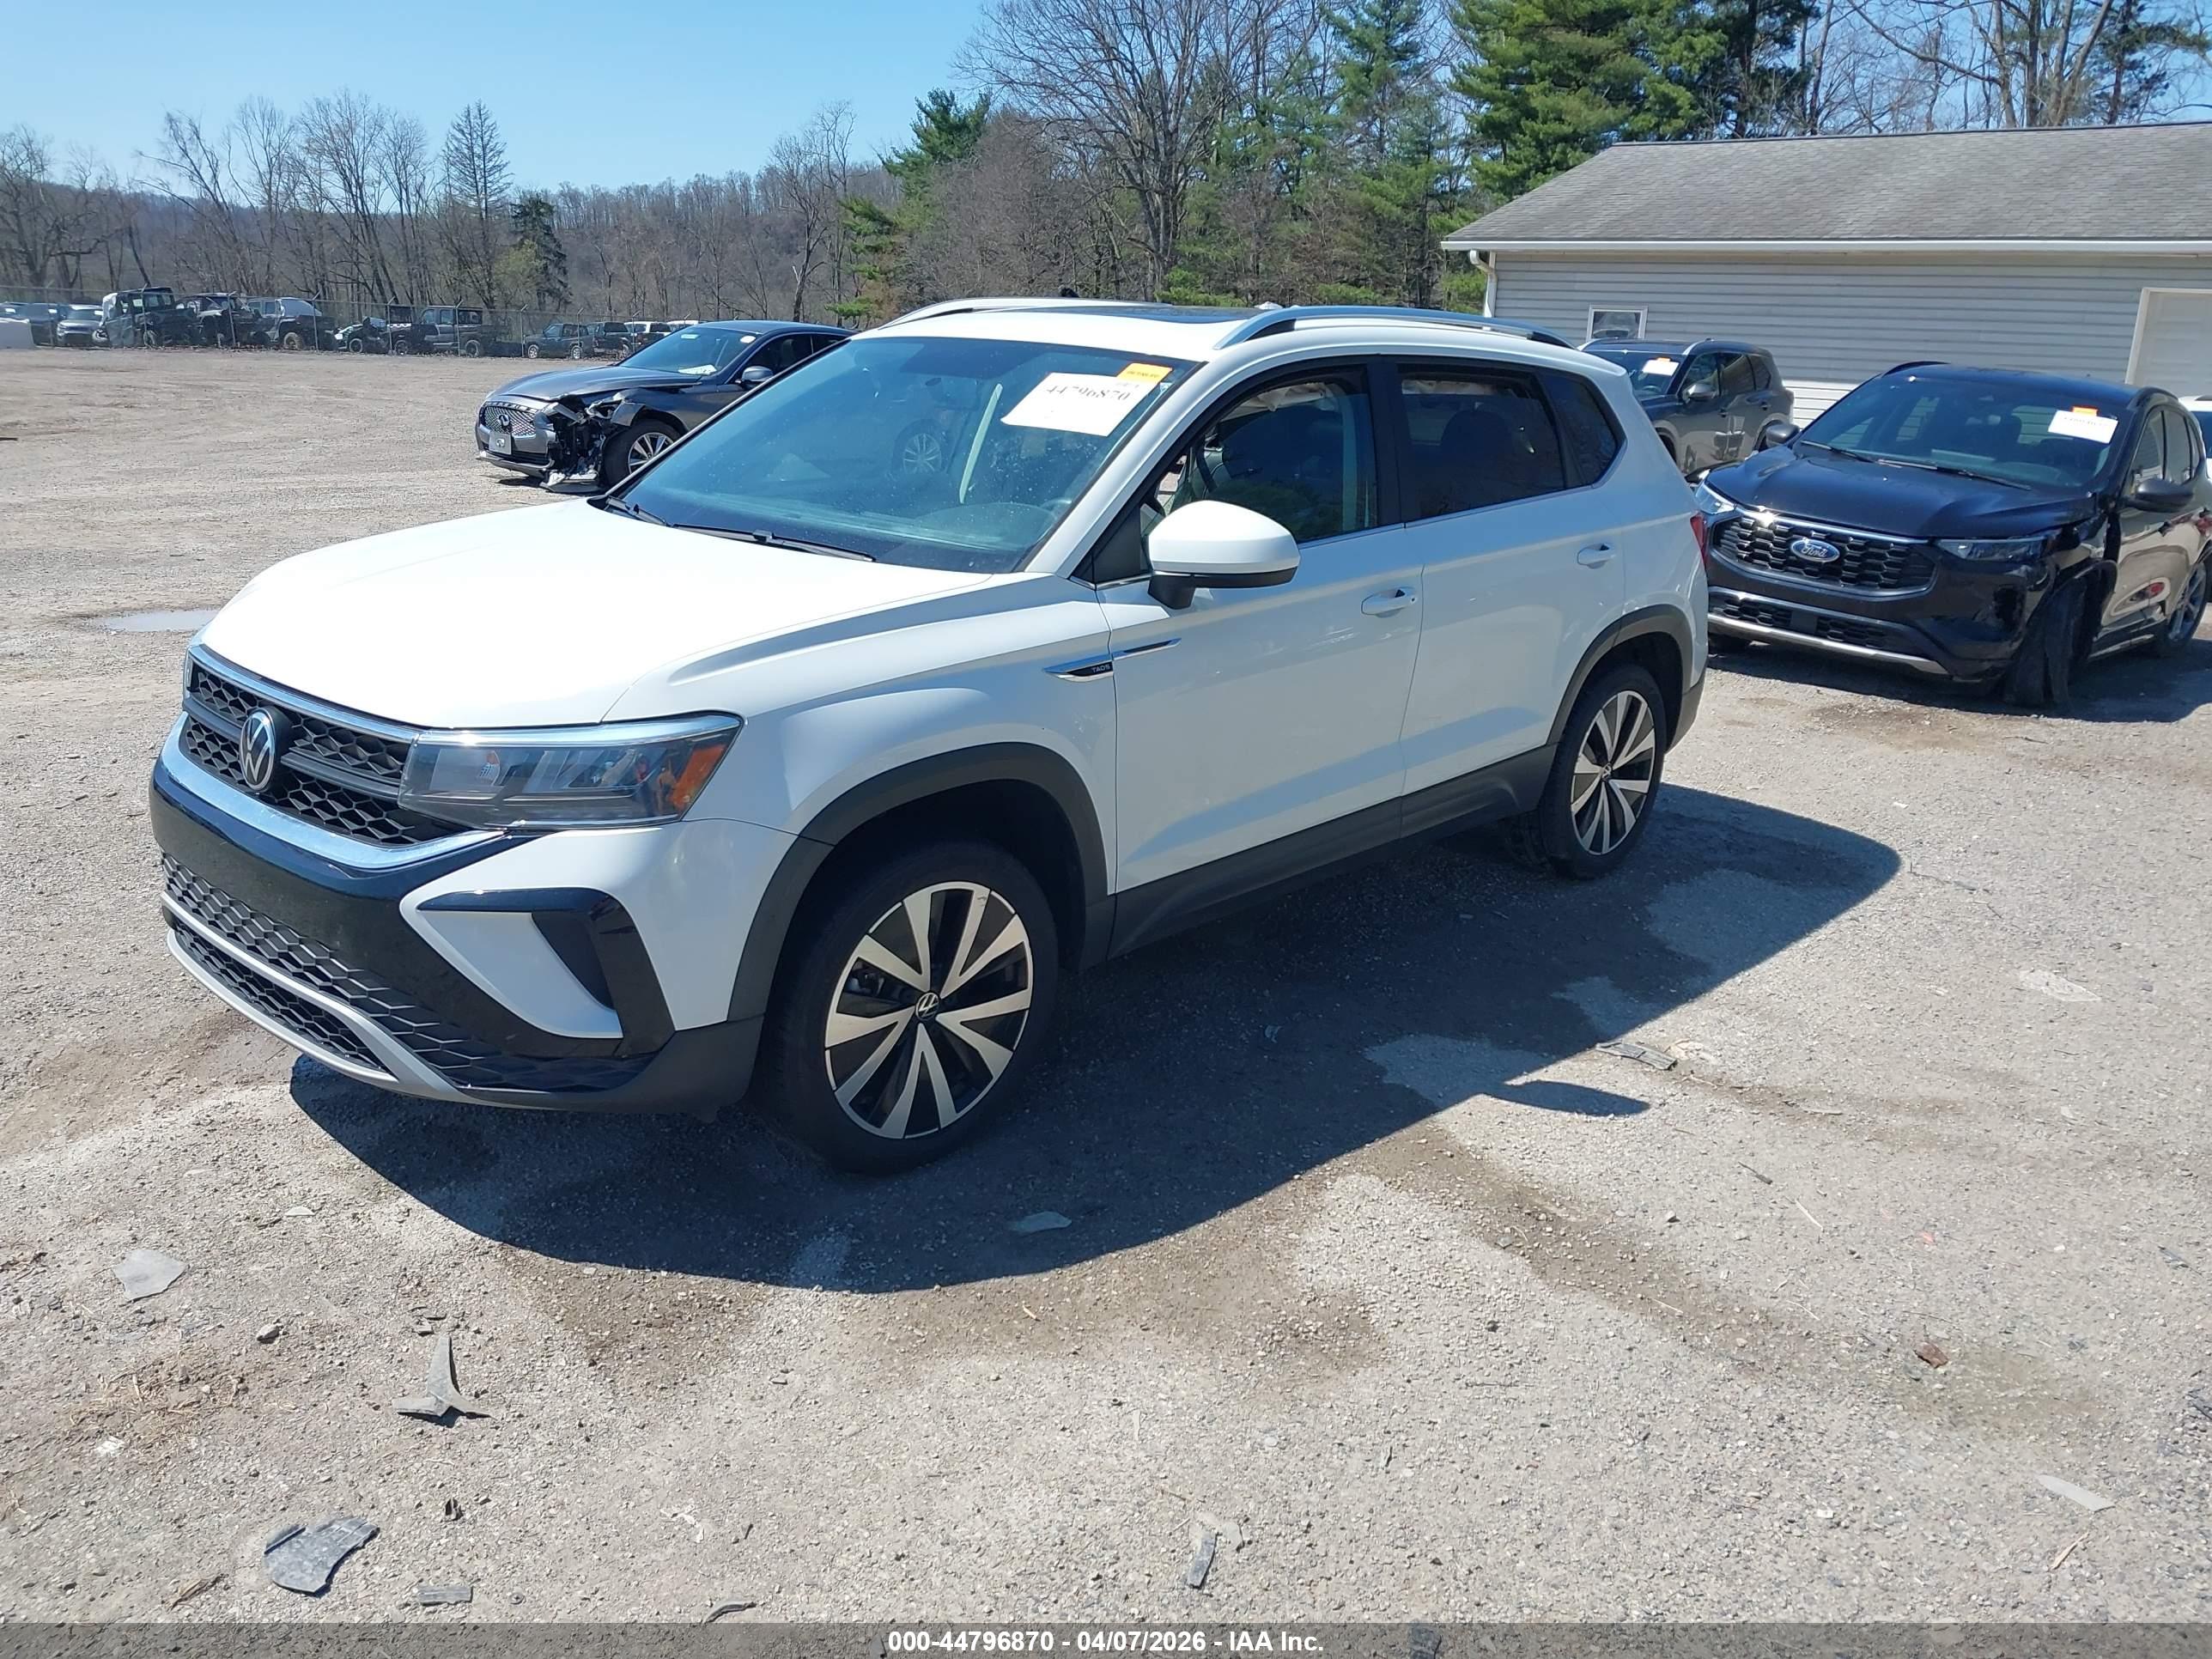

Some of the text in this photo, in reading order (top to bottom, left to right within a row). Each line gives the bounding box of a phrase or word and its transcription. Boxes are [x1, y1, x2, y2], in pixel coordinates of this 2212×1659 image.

[1046, 385, 1131, 401] 44796870
[1801, 543, 1829, 558] Ford
[1091, 664, 1110, 672] TAOS
